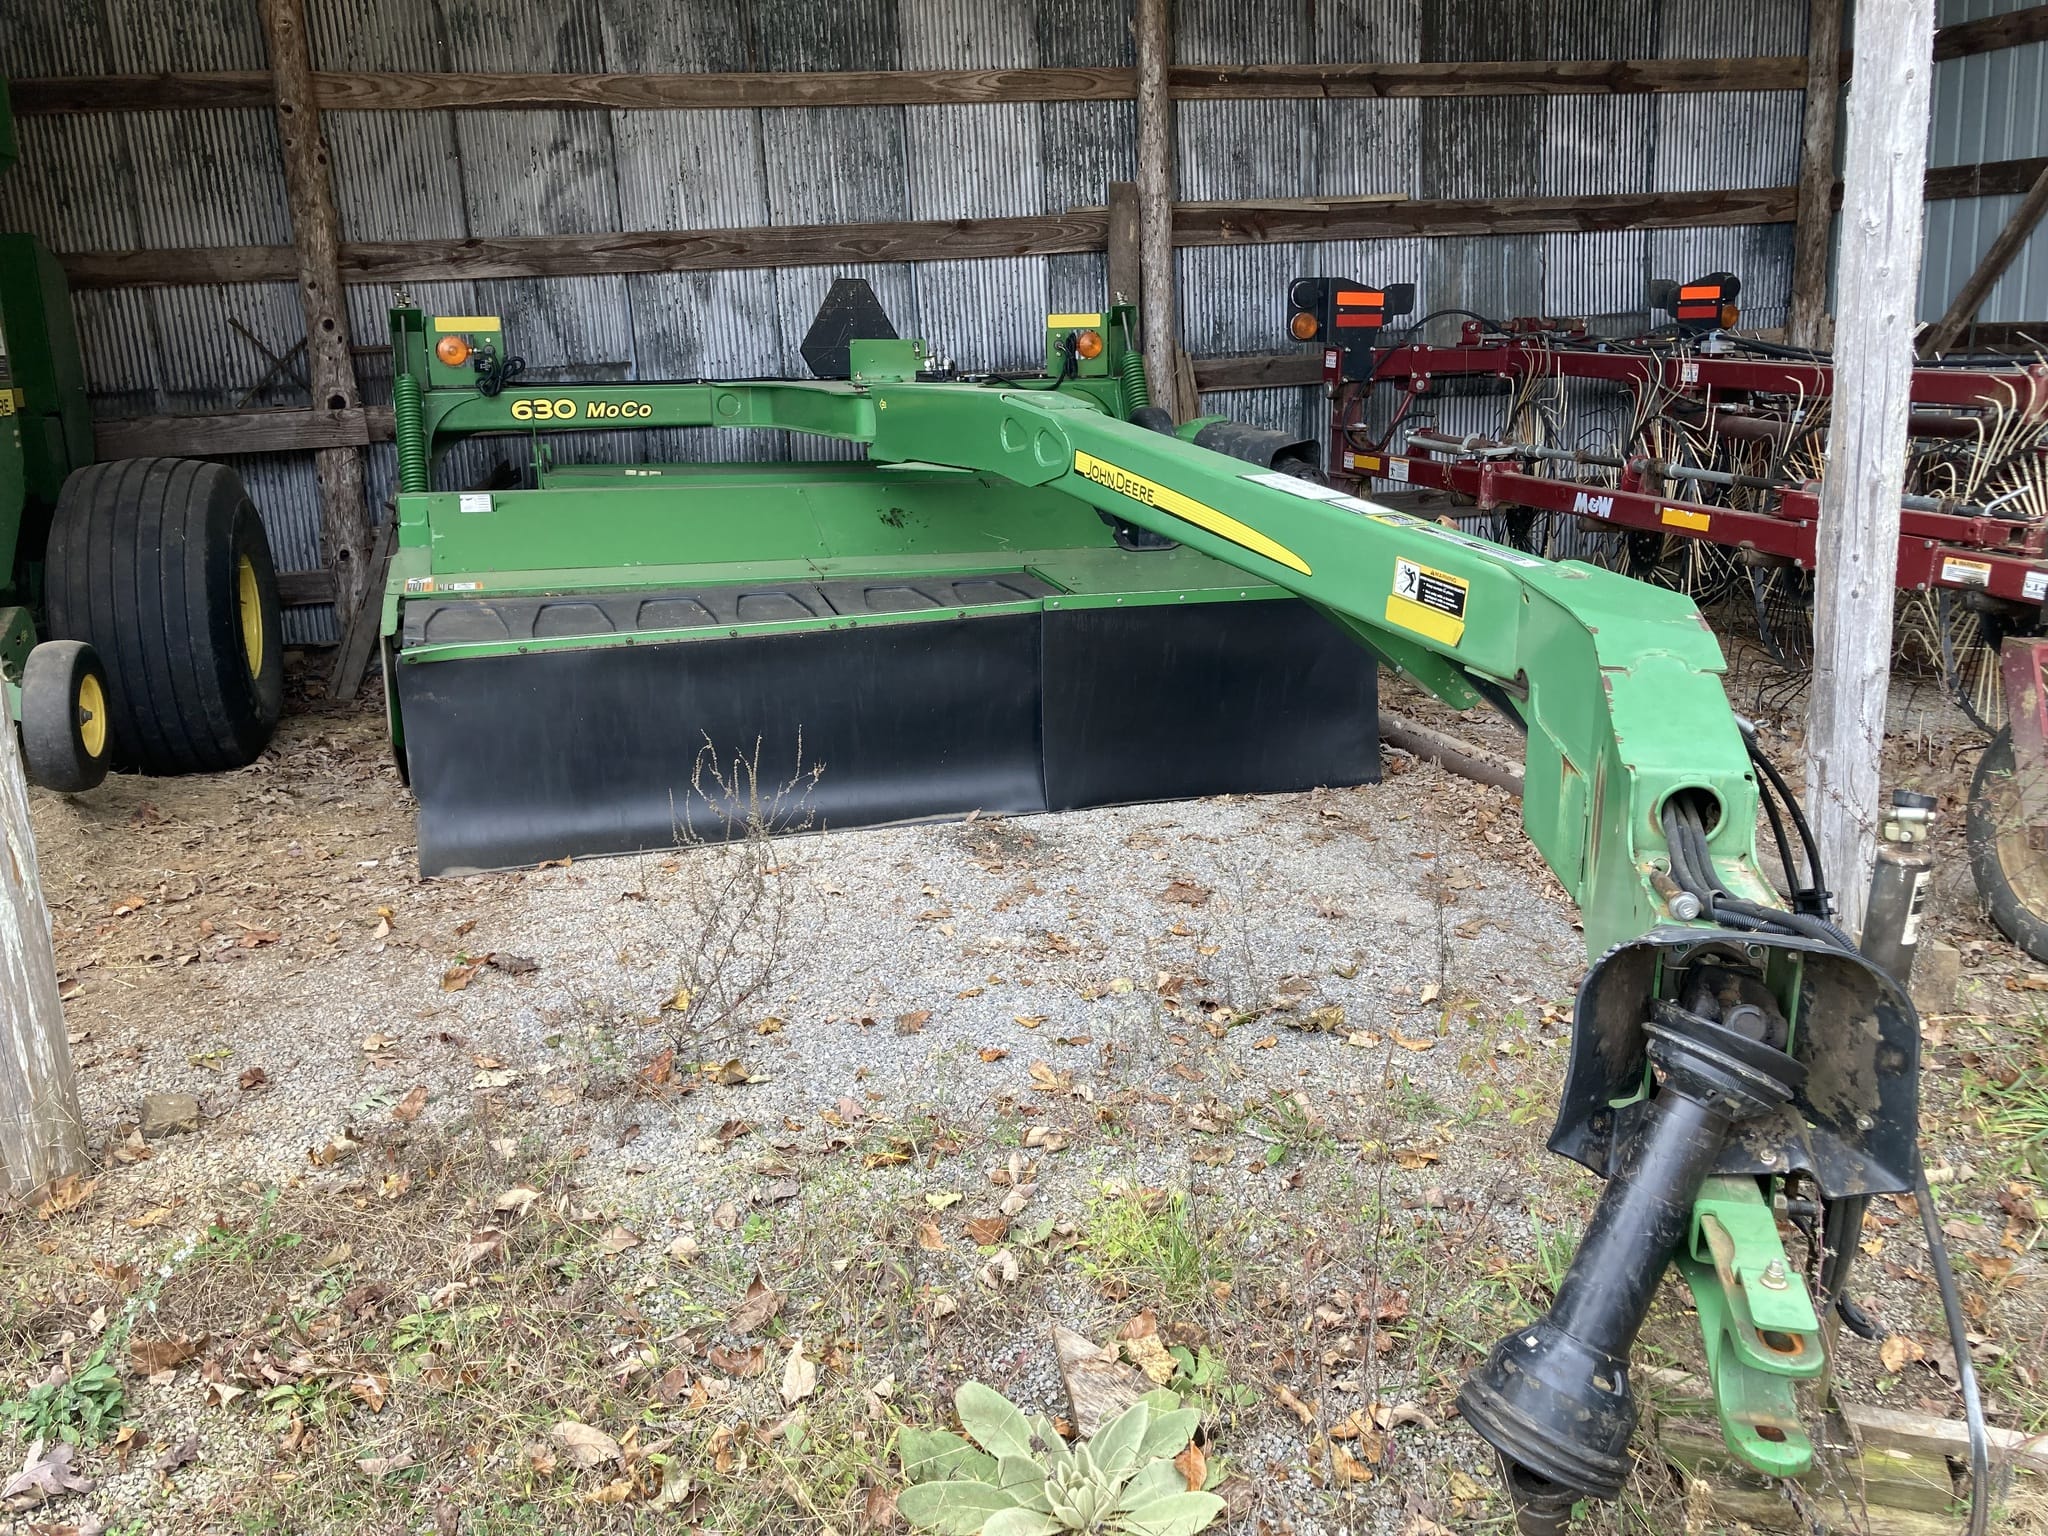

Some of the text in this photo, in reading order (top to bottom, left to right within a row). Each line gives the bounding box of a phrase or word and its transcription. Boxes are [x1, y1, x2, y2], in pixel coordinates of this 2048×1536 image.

[511, 398, 652, 420] 630 MoCo
[1085, 460, 1155, 504] JOHN DEERE
[1573, 492, 1614, 519] M&W
